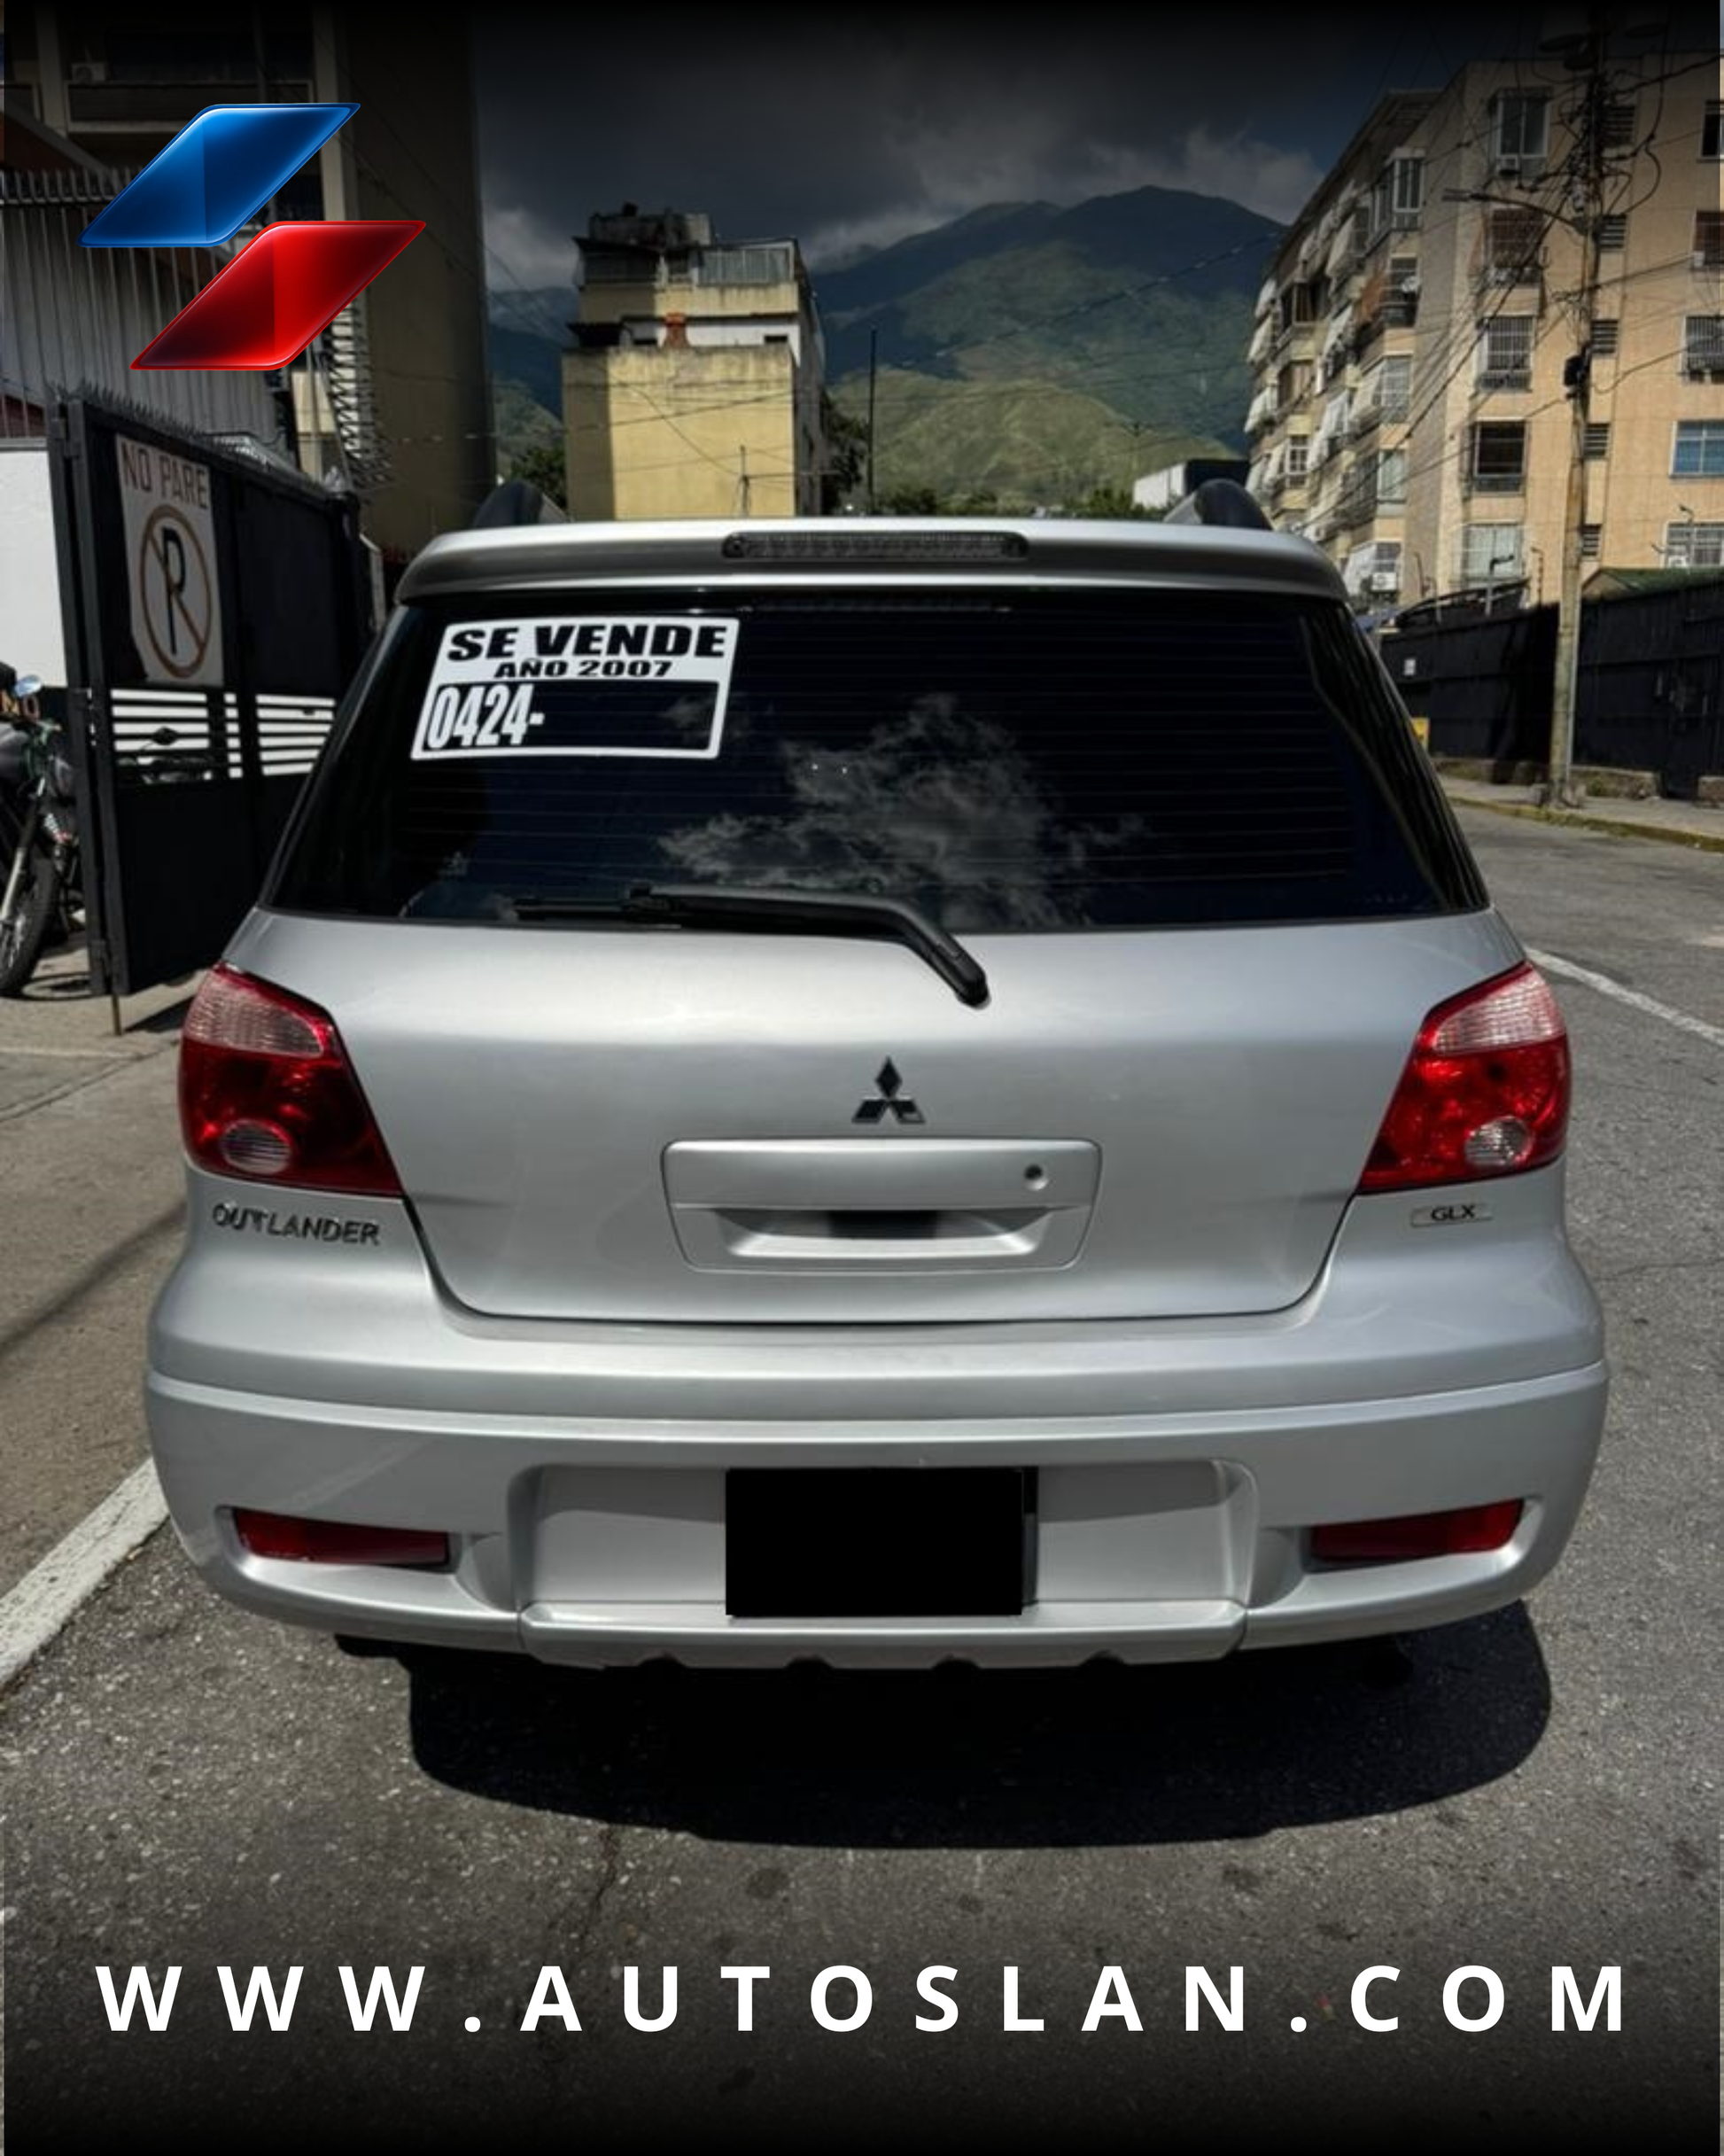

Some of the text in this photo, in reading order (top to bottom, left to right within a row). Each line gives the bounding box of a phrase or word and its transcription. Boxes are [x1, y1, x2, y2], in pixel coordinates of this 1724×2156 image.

[120, 442, 209, 510] NO PARE
[447, 625, 728, 661] SE VENDE
[493, 658, 673, 678] AÑO 2007
[426, 683, 545, 749] 0424-
[213, 1203, 380, 1246] OUTLANDER
[1431, 1204, 1475, 1221] GLX
